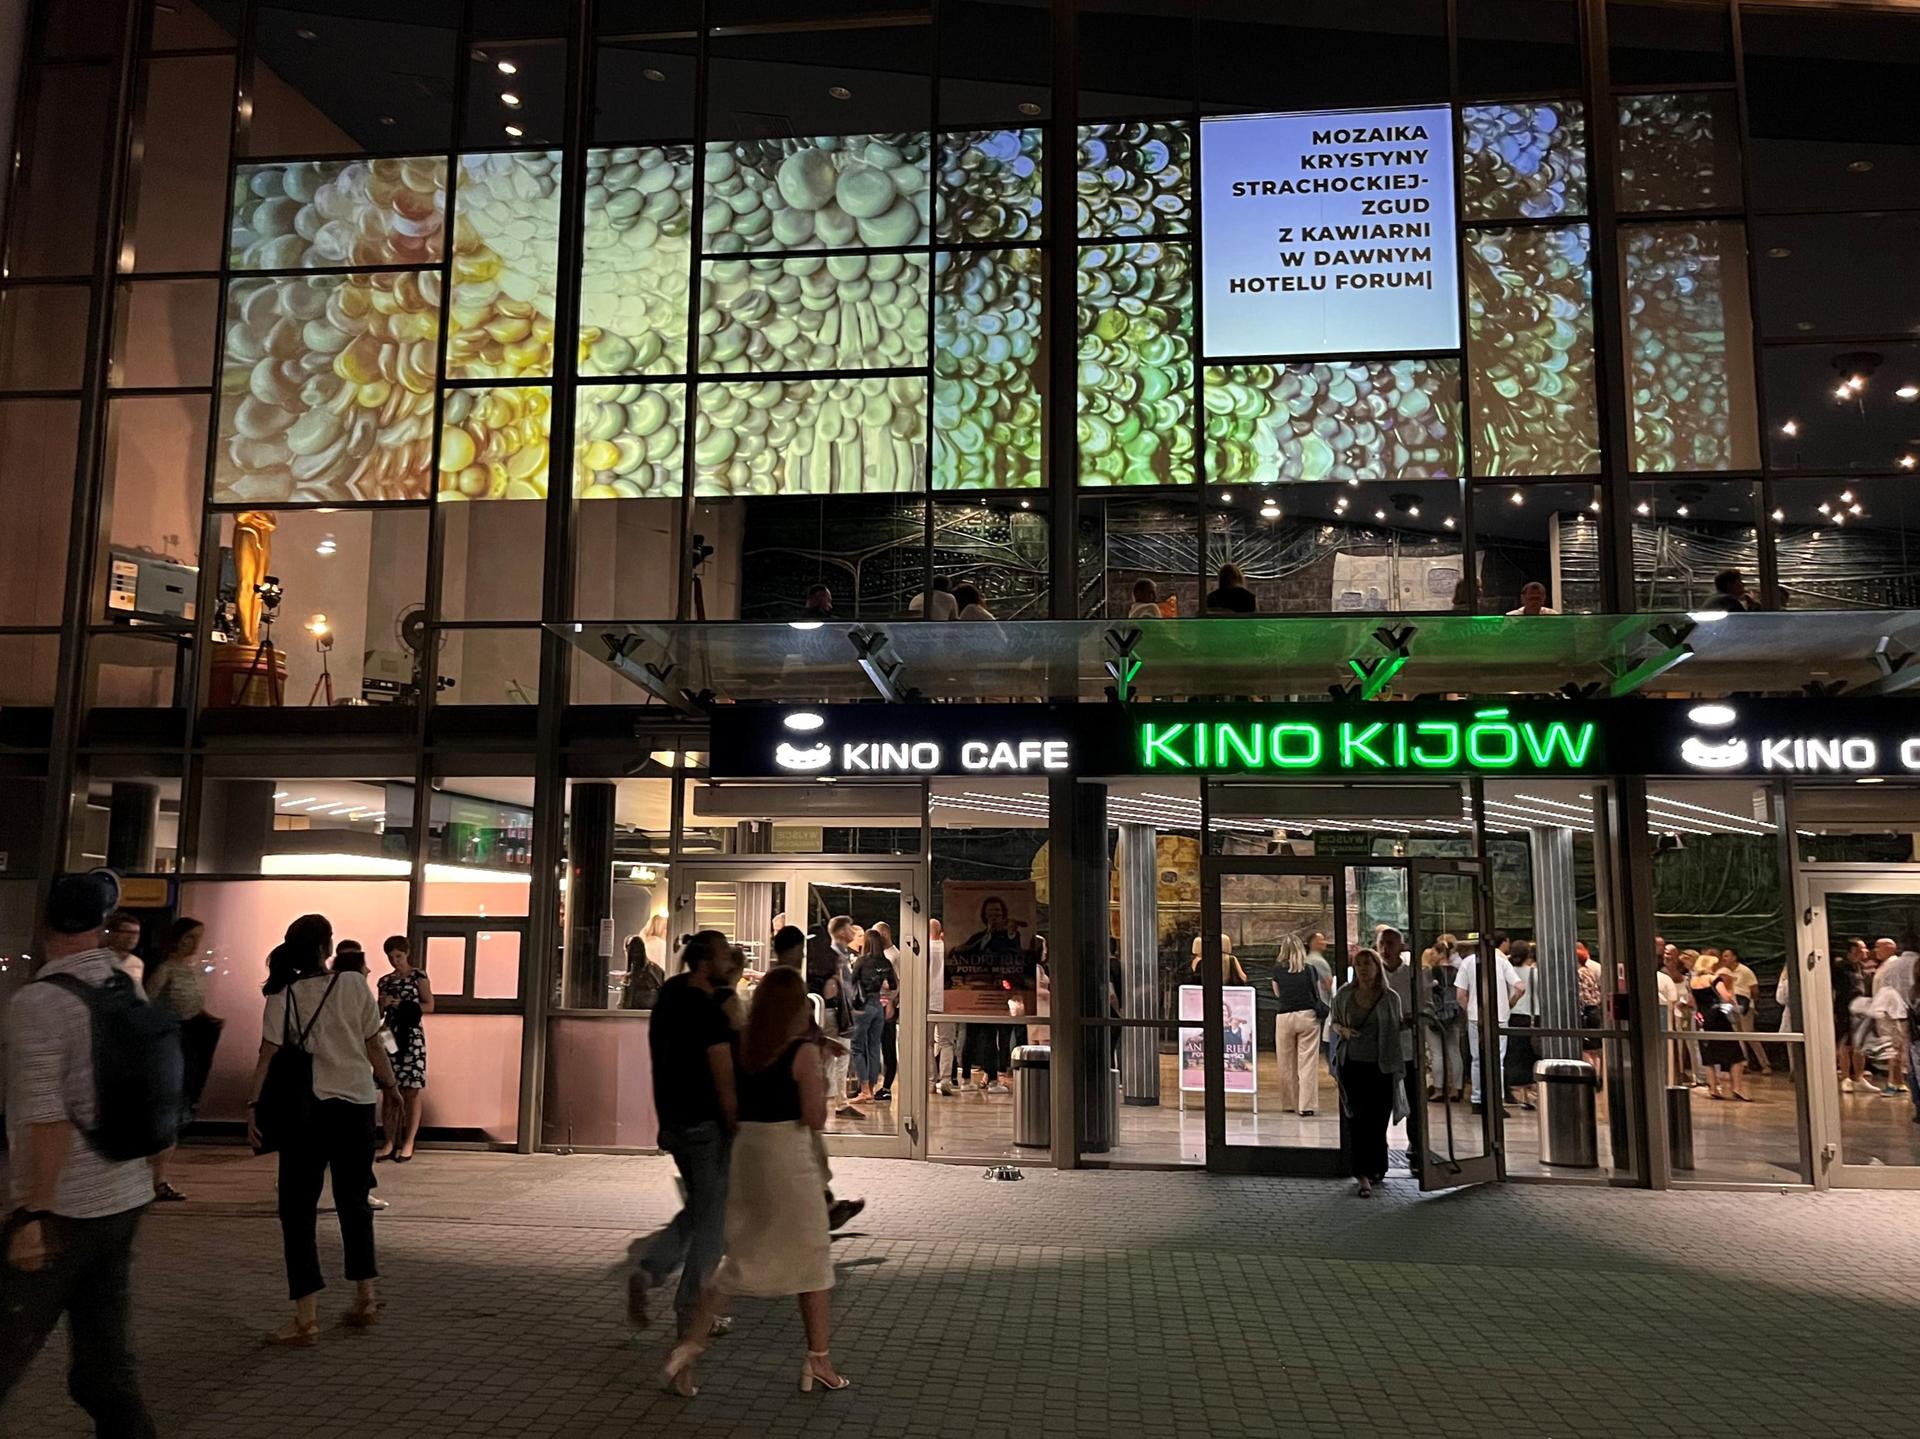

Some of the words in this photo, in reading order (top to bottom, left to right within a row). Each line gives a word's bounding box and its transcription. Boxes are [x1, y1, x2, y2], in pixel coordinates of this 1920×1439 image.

[1312, 125, 1428, 145] MOZAIKA
[1300, 149, 1429, 170] KRYSTYNY
[1232, 174, 1429, 197] STRACHOCKIEJ-
[1361, 198, 1430, 215] ZGUD
[1279, 227, 1293, 243] Z
[1302, 222, 1431, 242] KAWIARNI
[1280, 251, 1305, 267] W
[1314, 247, 1431, 266] DAWNYM
[1230, 275, 1326, 294] HOTELU
[1142, 722, 1322, 768] KINO
[1340, 707, 1594, 768] KIJÓW
[843, 742, 940, 770] KINO
[961, 741, 1069, 769] CAFE
[1761, 738, 1876, 769] KINO
